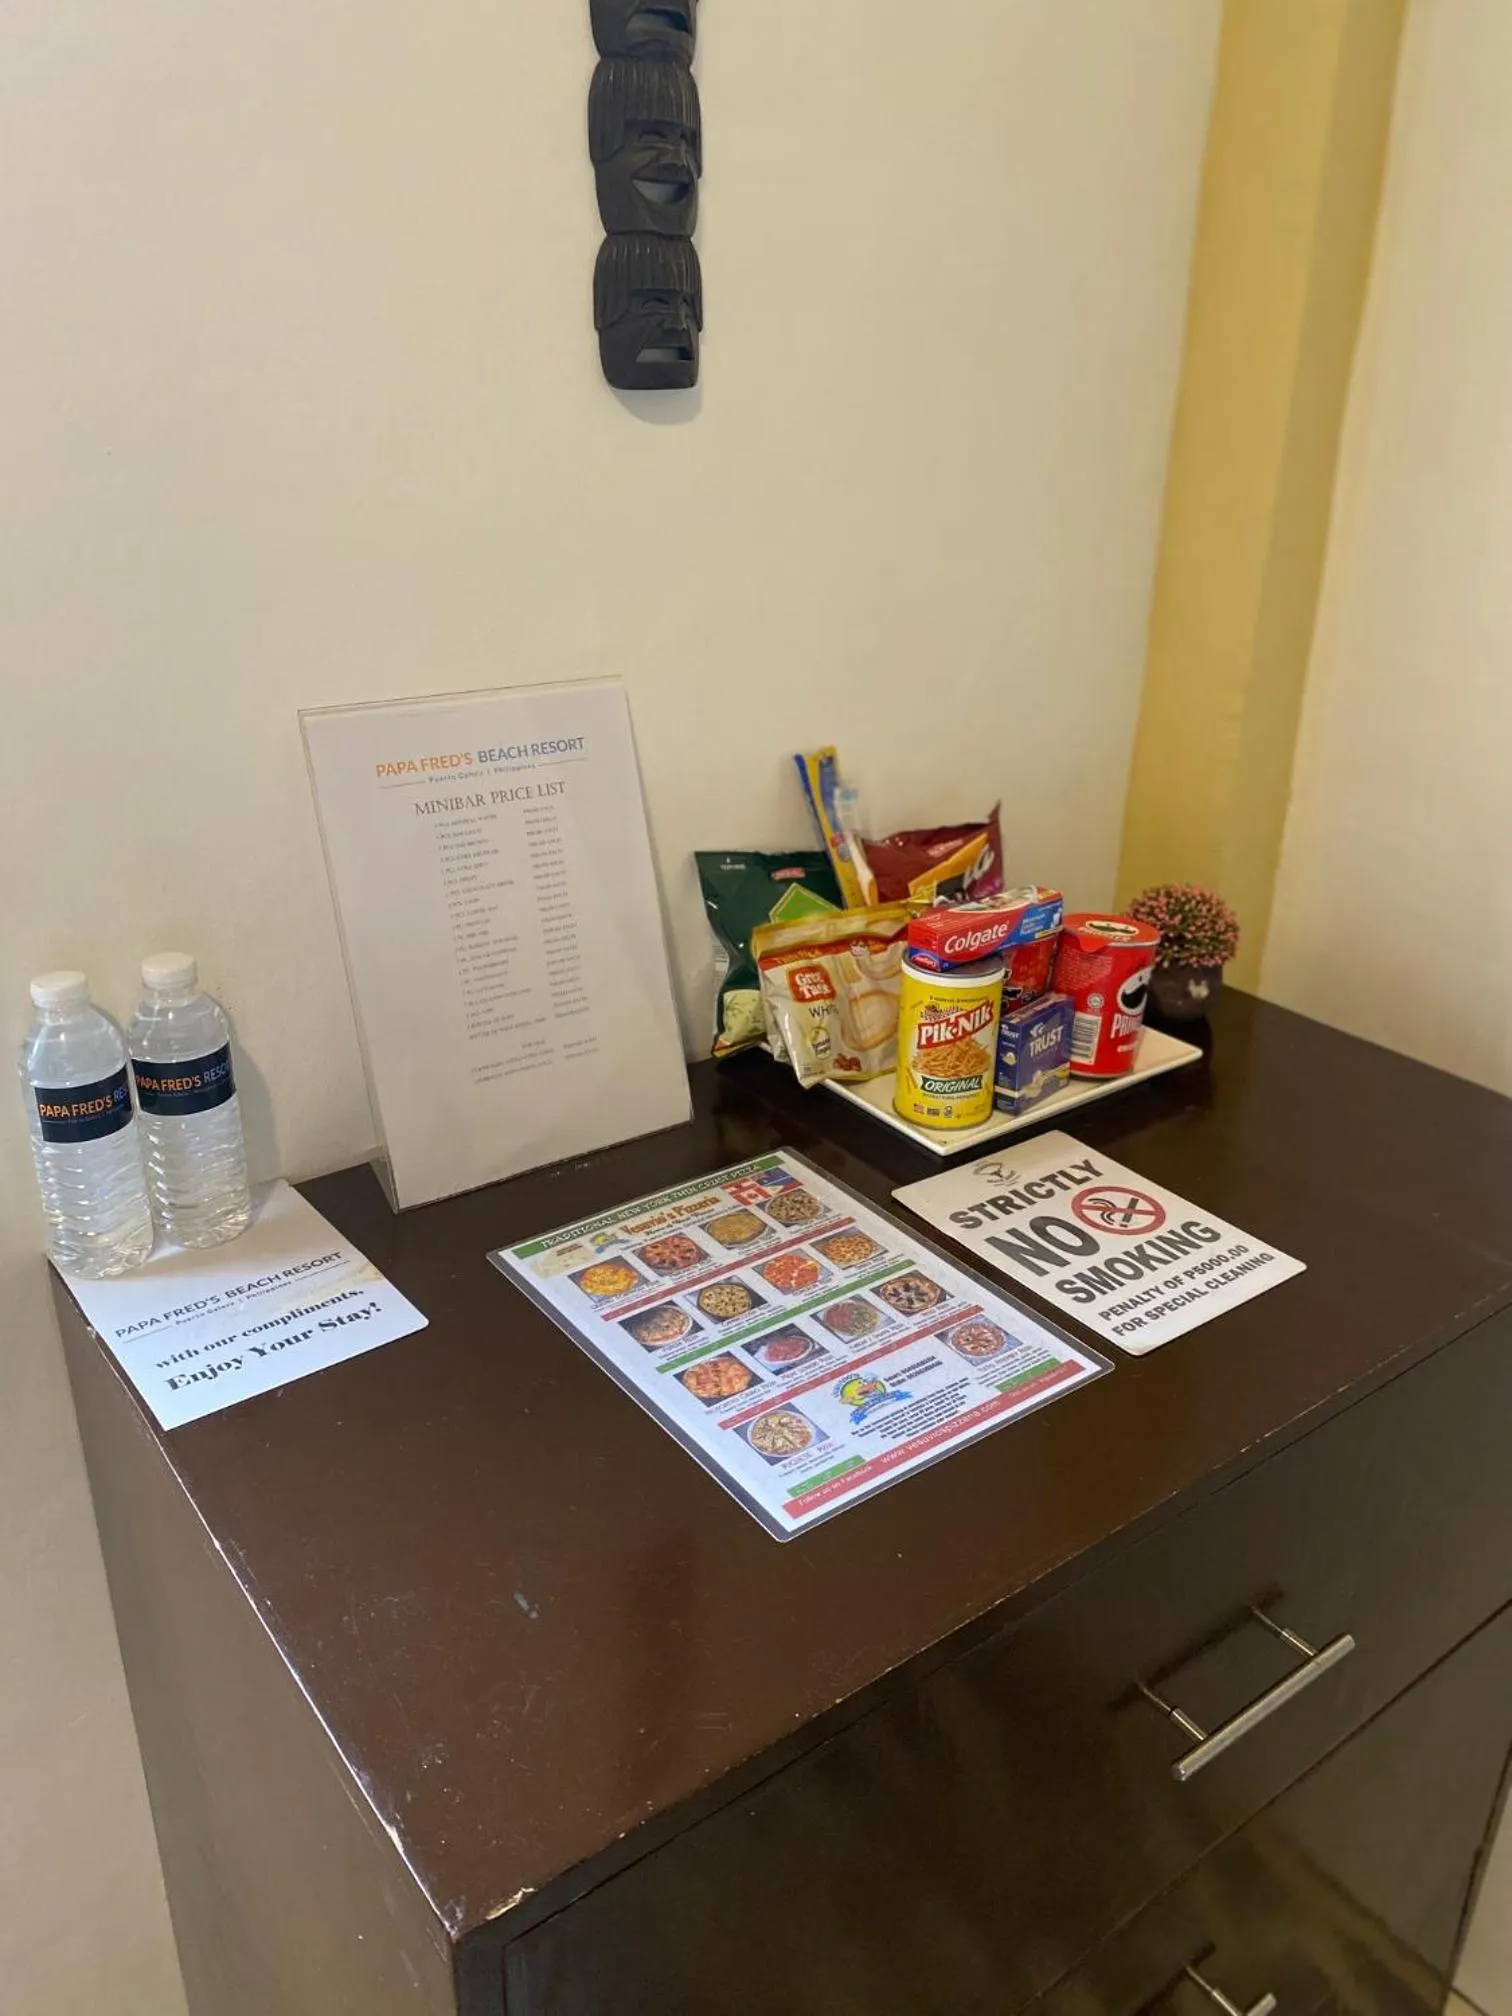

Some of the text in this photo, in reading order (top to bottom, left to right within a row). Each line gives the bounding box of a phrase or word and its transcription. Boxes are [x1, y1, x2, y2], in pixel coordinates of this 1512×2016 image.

[376, 737, 584, 777] PAPA FRED'S BEACH RESORT
[414, 782, 565, 816] MINIBAR PRICE LIST
[944, 922, 1009, 954] Colgate
[1030, 1025, 1064, 1058] TRUST
[39, 1103, 70, 1119] PAPA
[71, 1094, 113, 1117] FRED'S
[160, 1075, 201, 1091] FRED'S
[925, 1078, 980, 1093] ORIGINAL
[617, 1206, 641, 1219] NEW
[949, 1159, 1103, 1229] STRICTLY
[984, 1216, 1100, 1277] NO
[1055, 1221, 1221, 1303] SMOKING
[115, 1252, 342, 1337] PAPA FRED'S BEACH RESORT
[1098, 1245, 1249, 1321] PENALTY OF P5000.00
[1112, 1253, 1275, 1336] FOR SPECIAL CLEANING
[156, 1291, 363, 1368] with our compliments,
[167, 1302, 381, 1390] Enjoy Your Stay!
